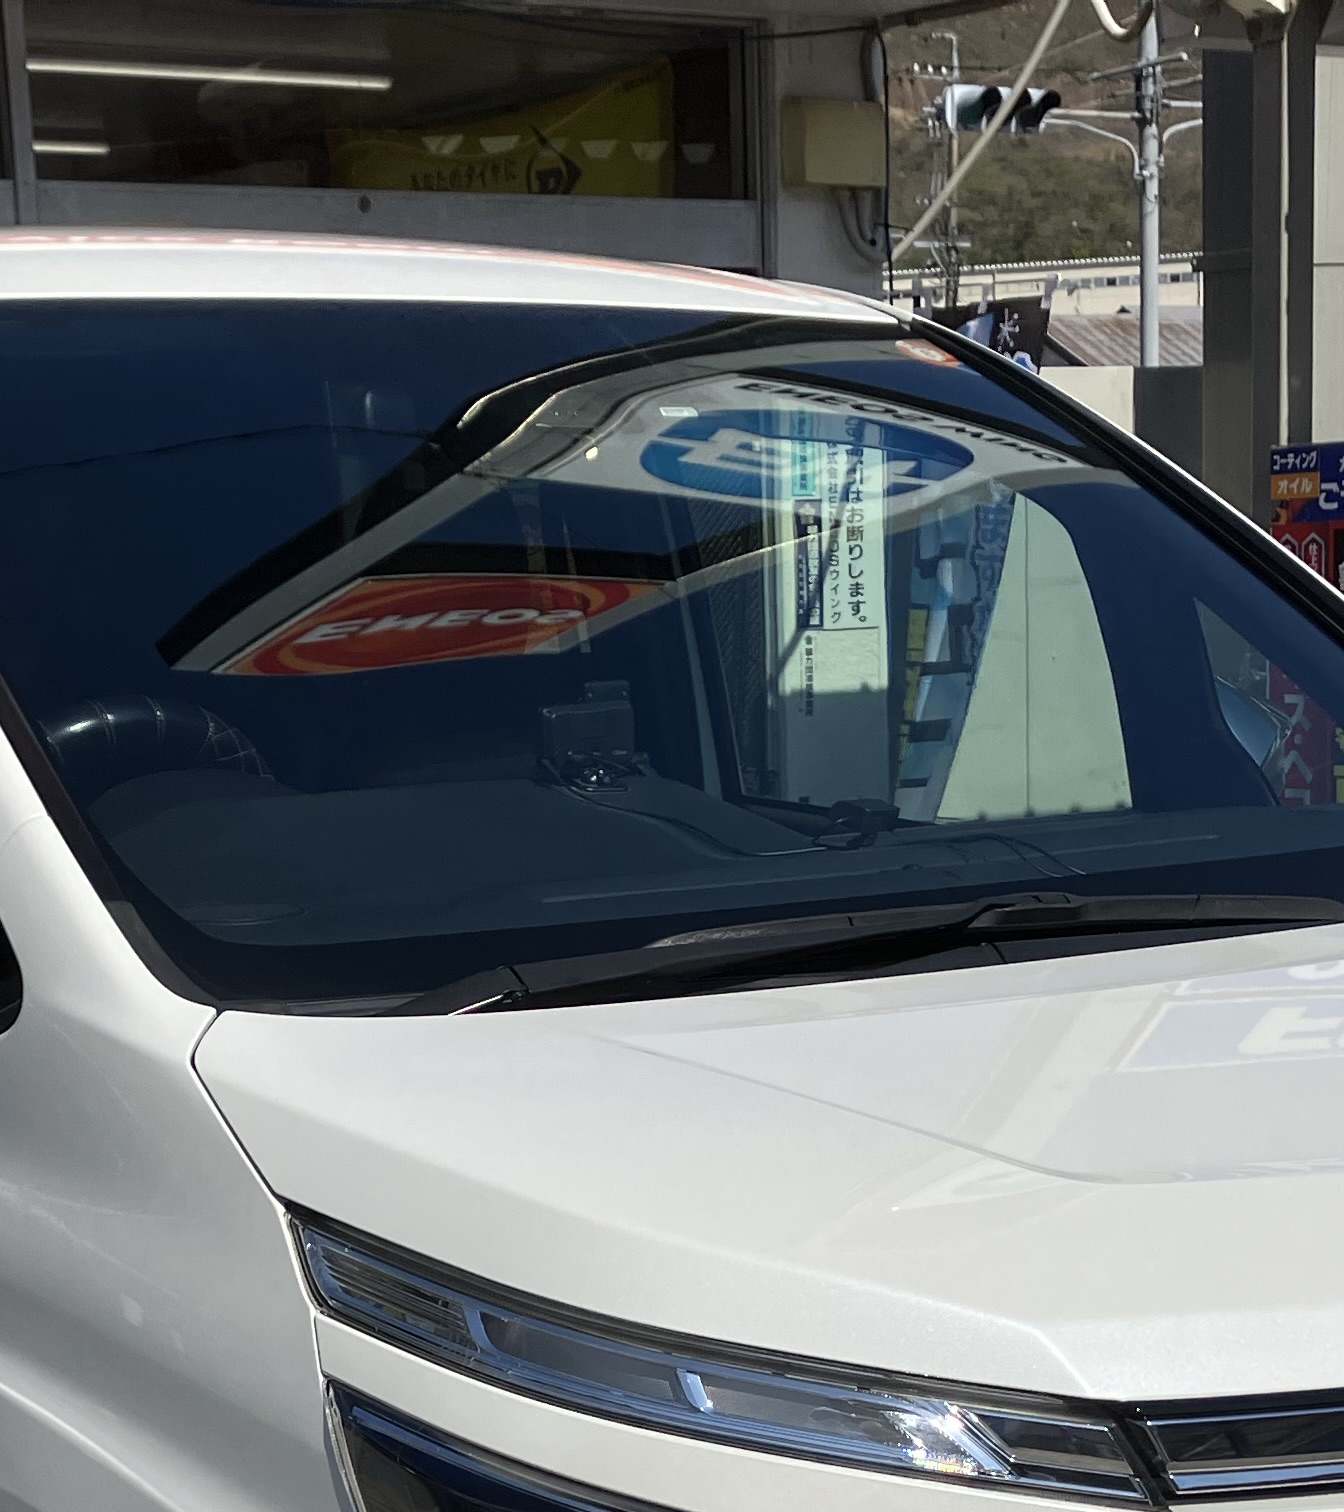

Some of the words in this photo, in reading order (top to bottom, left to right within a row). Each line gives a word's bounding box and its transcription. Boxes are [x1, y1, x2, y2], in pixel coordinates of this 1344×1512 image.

[1272, 451, 1317, 471] コーティング
[1276, 477, 1313, 495] オイル
